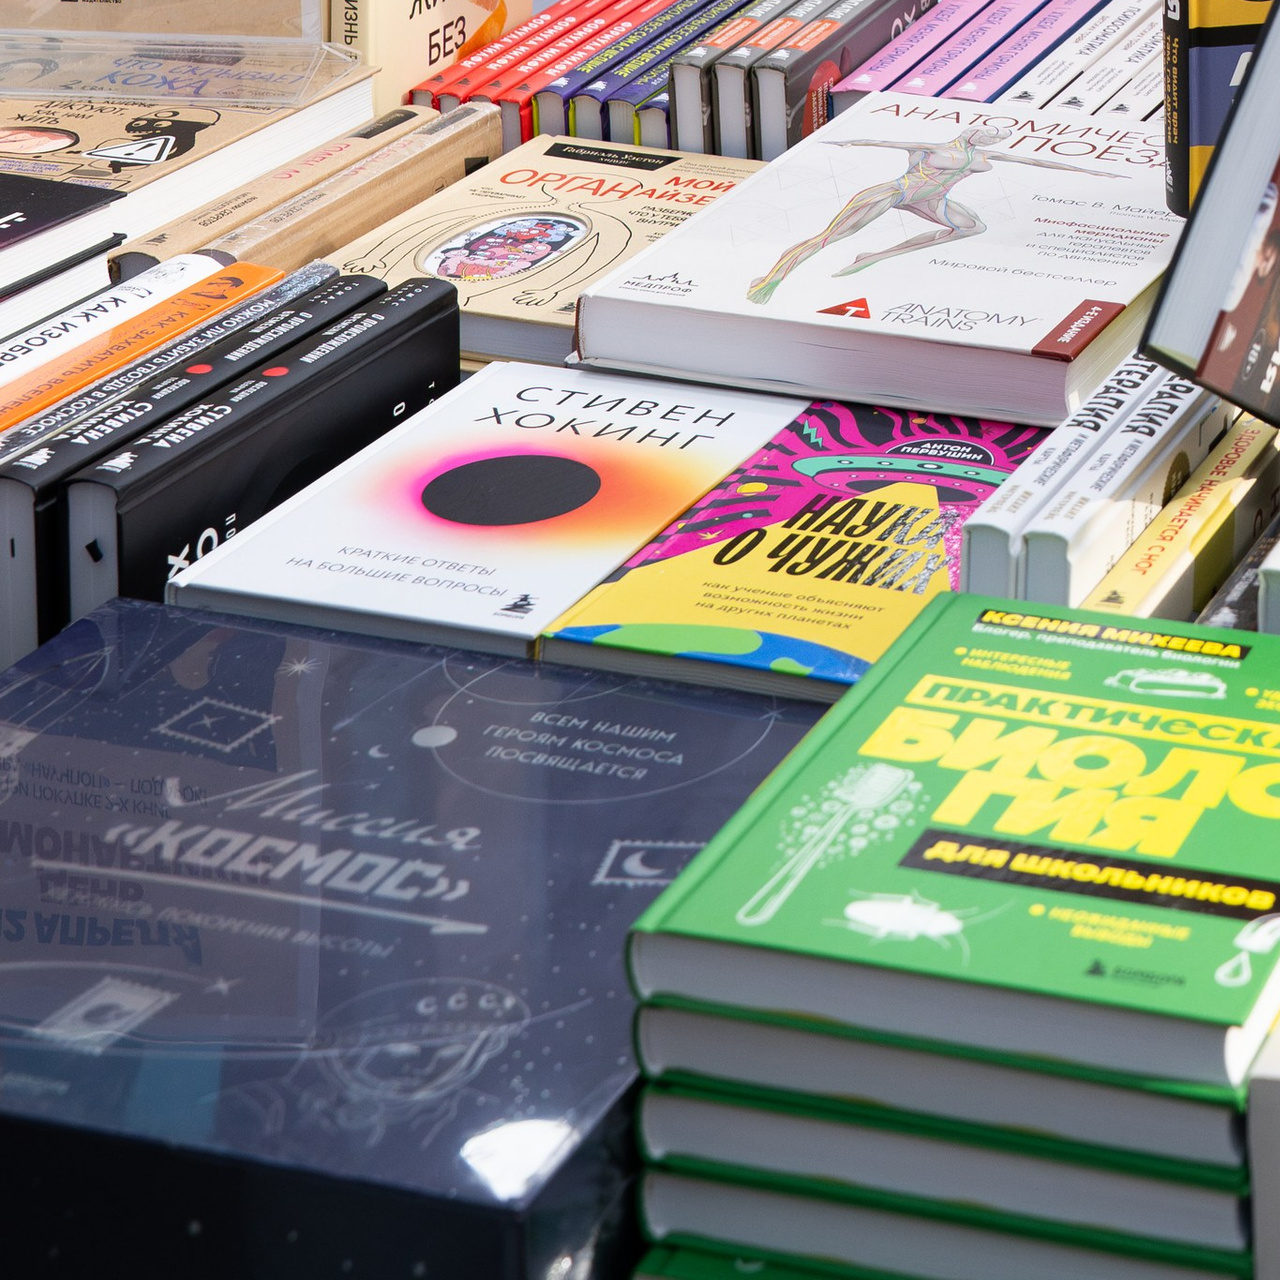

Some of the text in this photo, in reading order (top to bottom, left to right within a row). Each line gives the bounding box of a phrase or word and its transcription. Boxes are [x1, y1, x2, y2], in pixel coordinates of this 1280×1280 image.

[429, 16, 467, 66] БЕЗ
[96, 70, 210, 94] КОЖА
[500, 169, 640, 199] ОРГАН
[664, 176, 736, 192] МОЙ
[1032, 194, 1087, 207] Томас
[1034, 217, 1171, 238] Миофасциальные
[1074, 228, 1165, 244] меридианы
[623, 280, 693, 293] МЕДПРОФ
[928, 258, 1117, 287] Мировой бестселлер
[890, 303, 1040, 328] ANATOMY
[515, 385, 737, 428] СТИВЕН
[70, 401, 153, 446] СТИВЕНА
[152, 404, 233, 449] СТИВЕНА
[474, 406, 715, 450] ХОКИНГ
[900, 444, 984, 461] ПЕРВУШИН
[920, 441, 972, 453] АНТОН
[781, 493, 961, 549] НАУКА
[1134, 478, 1221, 576] НАЧИНАЕТСЯ НОГ
[337, 545, 497, 577] КРАТКИЕ ОТВЕТЫ
[712, 528, 954, 595] О ЧУЖИХ
[315, 561, 508, 598] БОЛЬШИЕ ВОПРОСЫ
[702, 591, 864, 621] возможность жизни
[734, 585, 885, 613] ученые объясняют
[695, 601, 852, 630] на других планетах
[980, 610, 1242, 660] КСЕНИЯ МИХЕЕВА
[530, 711, 677, 743] ВСЕМ НАШИМ
[482, 725, 684, 765] ГЕРОЯМ КОСМОСА
[485, 746, 648, 780] ПОСВЯЩАЕТСЯ
[930, 769, 1207, 858] ГИЯ
[105, 819, 471, 902] «КОСМОС»
[923, 841, 1277, 911] ДЛЯ ШКОЛЬНИКОВ
